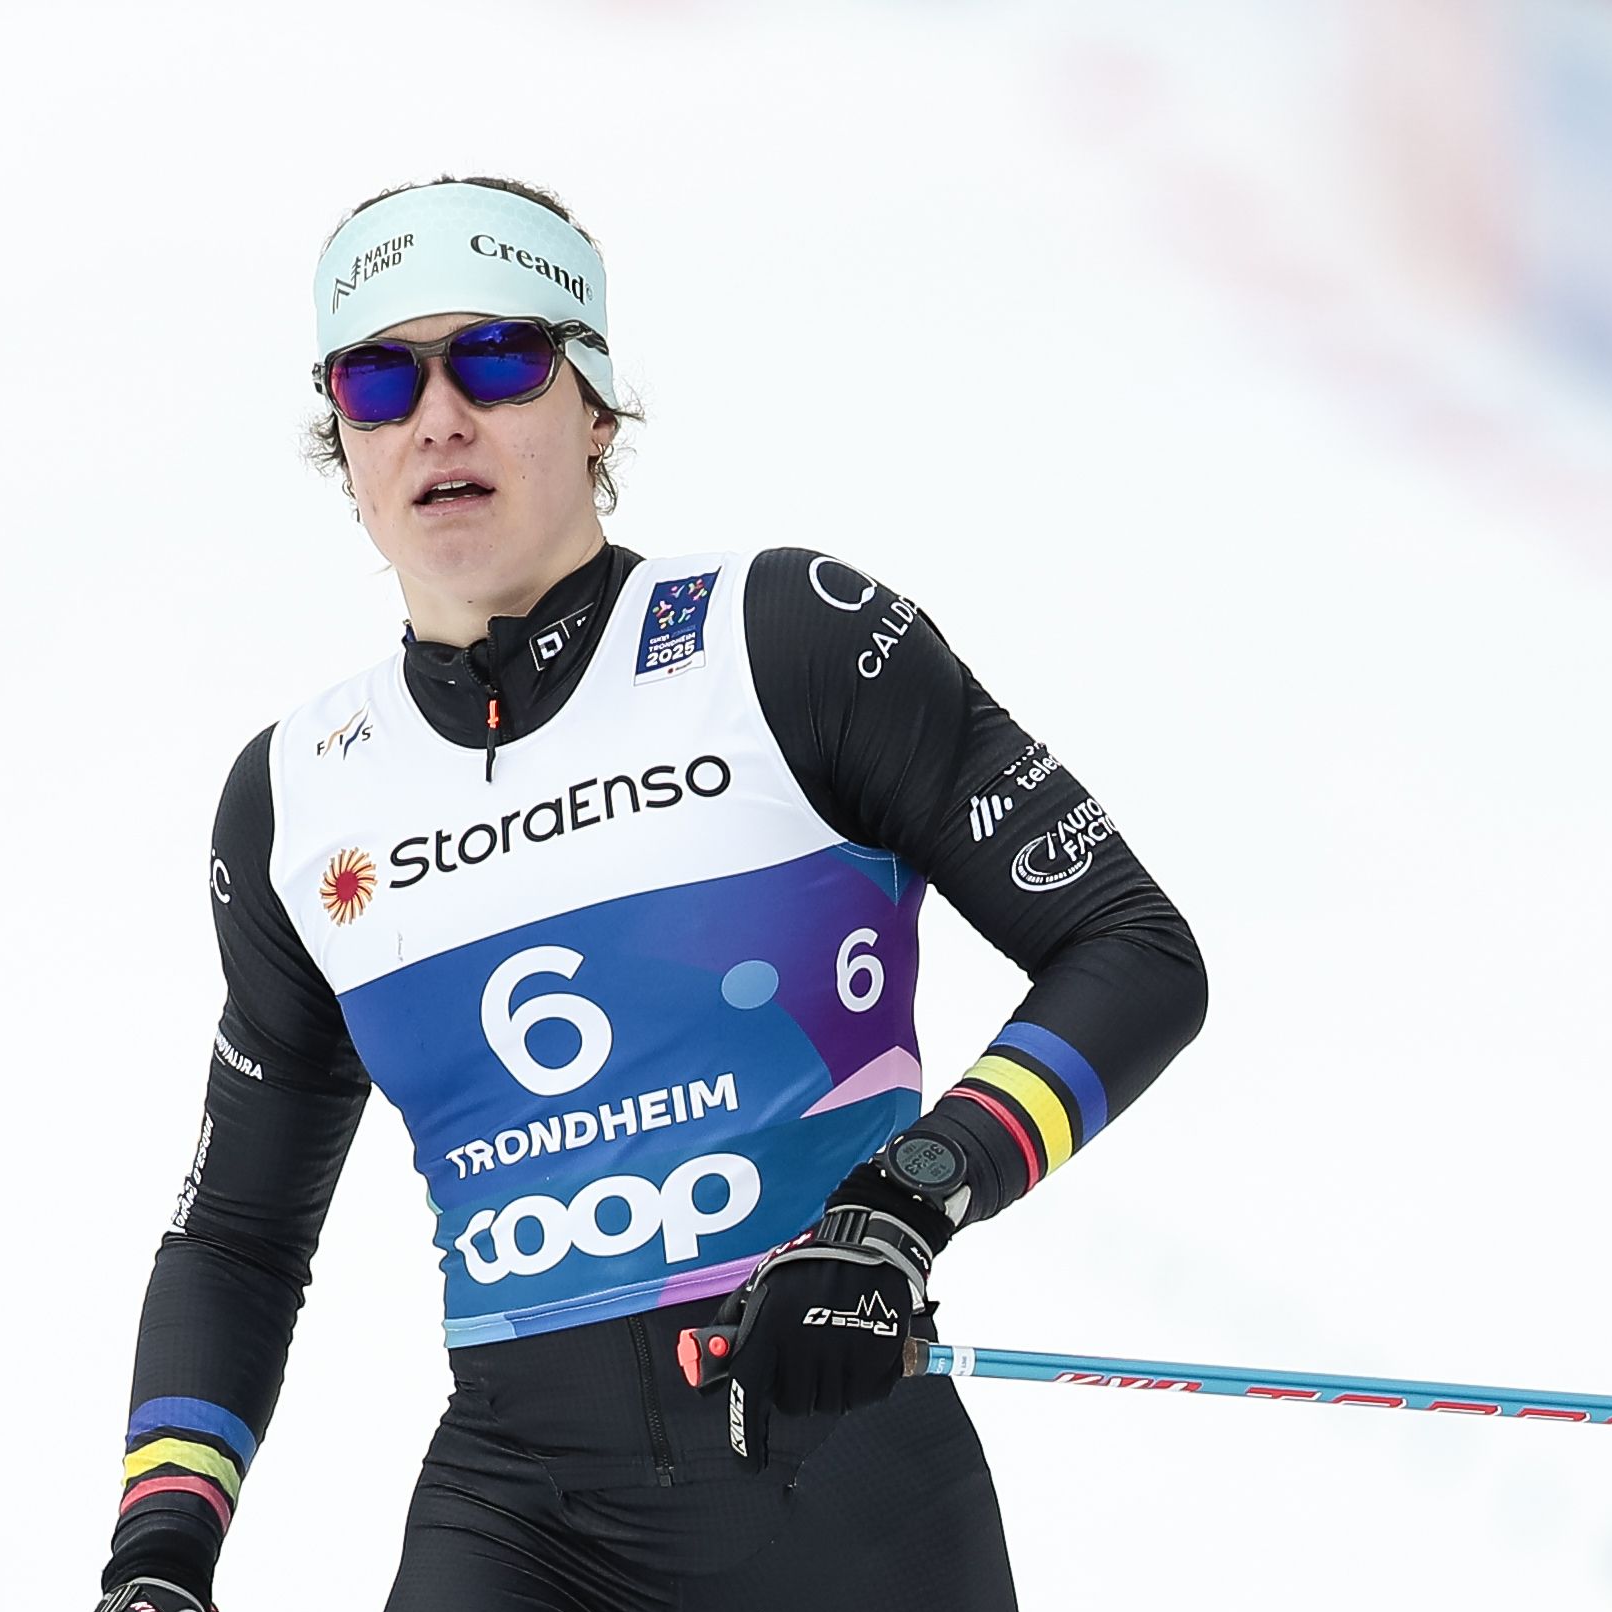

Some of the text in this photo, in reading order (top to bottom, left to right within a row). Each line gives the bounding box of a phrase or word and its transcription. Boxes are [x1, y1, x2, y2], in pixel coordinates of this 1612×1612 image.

[363, 252, 402, 283] LAND
[364, 233, 415, 266] NATUR
[470, 235, 586, 305] Creand
[646, 640, 695, 667] 2025
[316, 724, 373, 756] FIS
[835, 928, 885, 1012] 6
[480, 945, 613, 1097] 6
[445, 1072, 739, 1180] TRONDHEIM
[455, 1153, 761, 1285] coop
[729, 1378, 749, 1457] KV+
